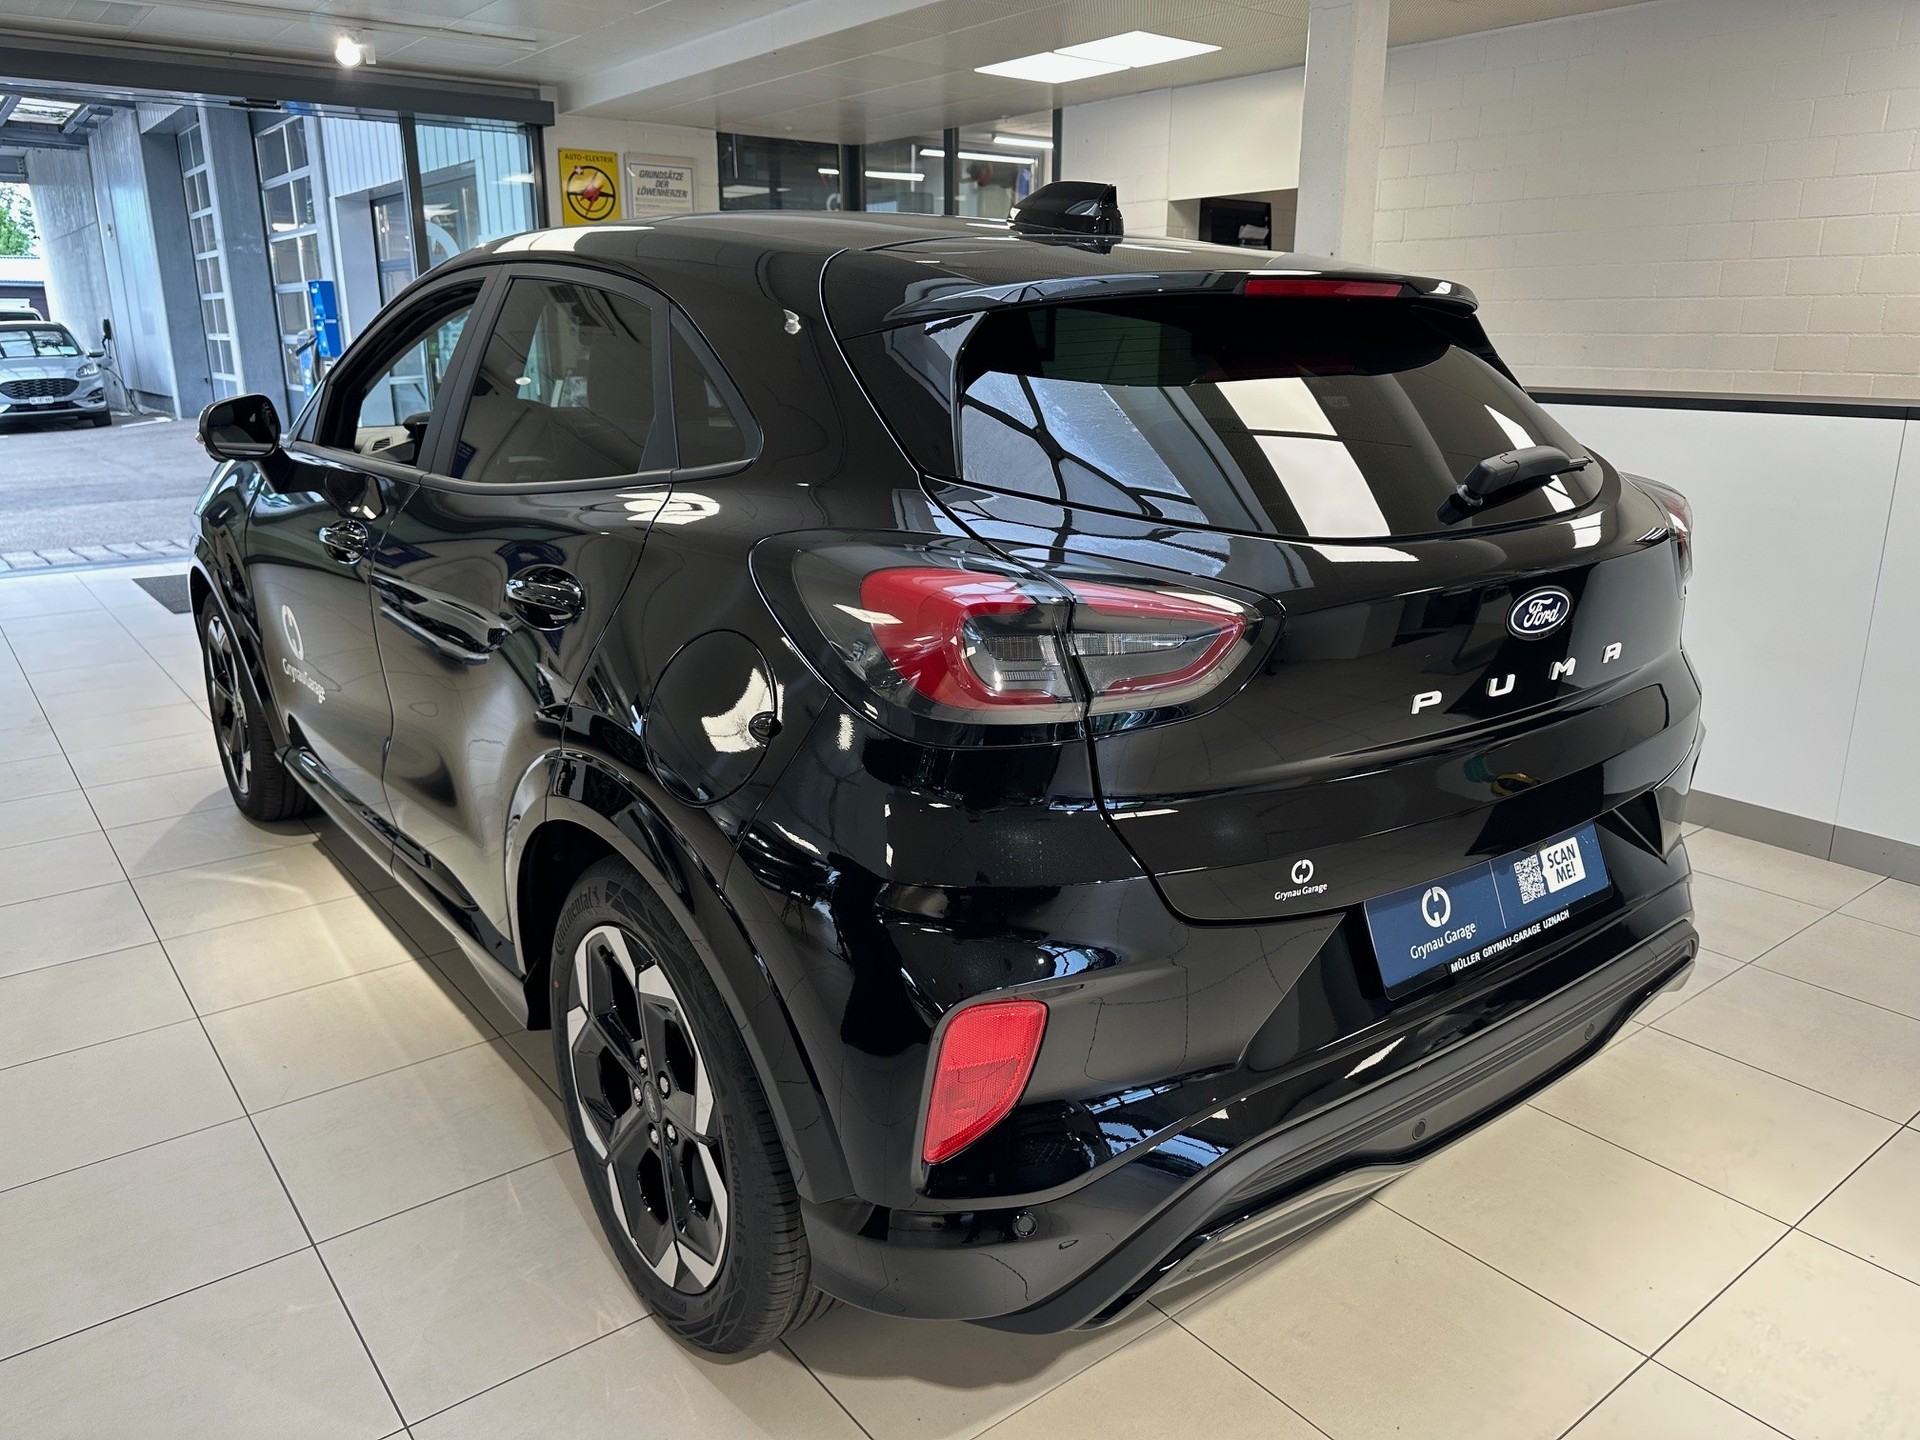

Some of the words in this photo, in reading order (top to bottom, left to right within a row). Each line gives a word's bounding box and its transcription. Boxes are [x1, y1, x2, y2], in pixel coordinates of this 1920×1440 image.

[565, 153, 614, 163] AUTO-ELEKTRIK
[639, 169, 684, 182] GRUNDSÄTZE
[655, 180, 670, 188] DER
[636, 186, 688, 198] LÖWENHERZEN
[1523, 597, 1561, 628] Ford
[1410, 642, 1623, 715] PUMA
[1547, 844, 1576, 869] SCAN
[1555, 863, 1576, 884] ME!
[1274, 888, 1302, 901] Grynau
[1302, 883, 1328, 894] Garage
[1410, 935, 1444, 960] Grynau
[1444, 922, 1477, 945] Garage
[1450, 952, 1481, 973] MÜLLER
[1482, 923, 1542, 958] GRYNAU-GARAGE
[1542, 909, 1570, 930] UZNACH
